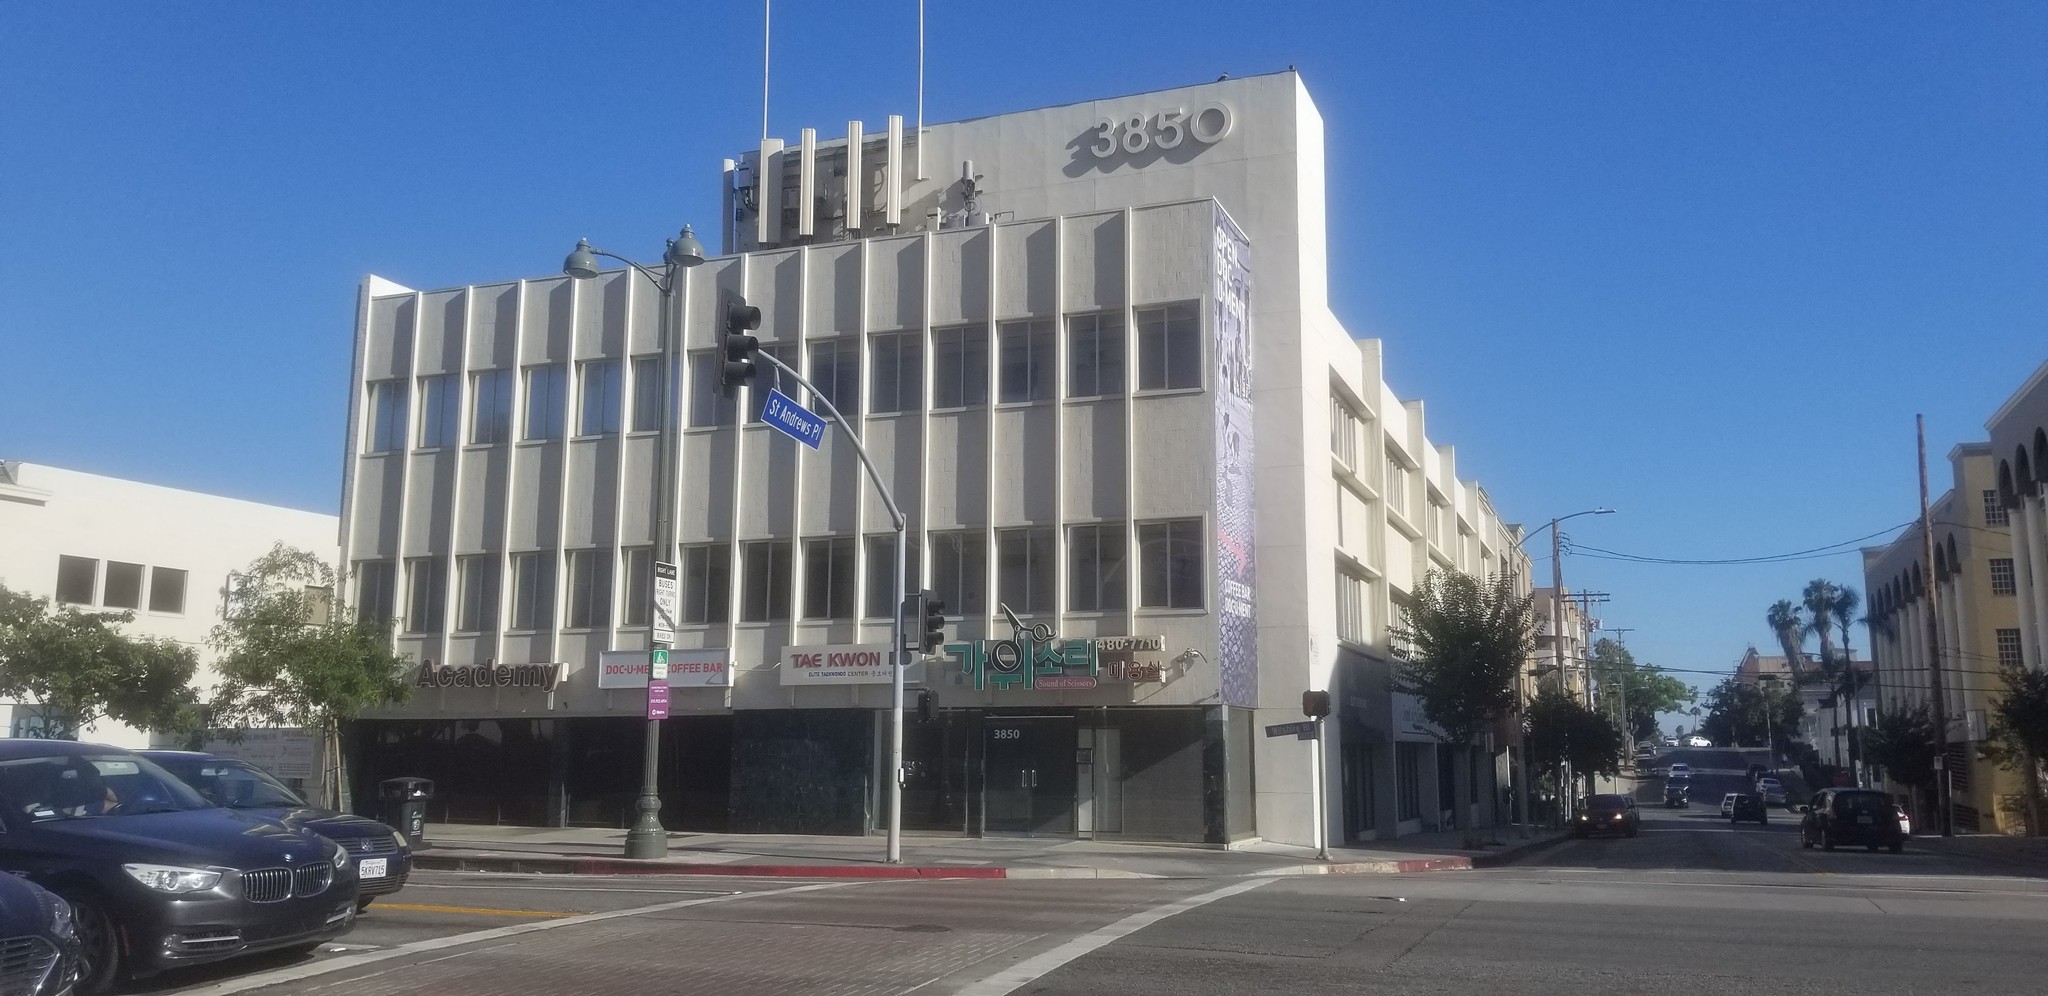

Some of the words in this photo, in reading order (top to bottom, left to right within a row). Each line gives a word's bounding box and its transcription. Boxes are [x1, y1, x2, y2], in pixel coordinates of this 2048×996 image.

[1091, 101, 1234, 158] 3850
[769, 399, 781, 417] St
[779, 405, 812, 435] Andrews
[811, 423, 822, 441] Pl
[666, 568, 676, 576] LANE
[658, 579, 674, 589] BUSES
[659, 597, 671, 606] ONLY
[1098, 638, 1161, 650] 480-7710
[790, 653, 823, 668] TAE
[827, 652, 881, 667] KWON
[944, 639, 1099, 690] 가위소리
[703, 663, 723, 673] BAR
[1107, 661, 1161, 680] 미용실
[416, 658, 562, 692] Academy
[1038, 679, 1058, 687] Sound
[1060, 679, 1066, 687] of
[1067, 679, 1092, 687] Scissors
[994, 729, 1020, 739] 3850
[361, 865, 385, 877] 5KRV715
